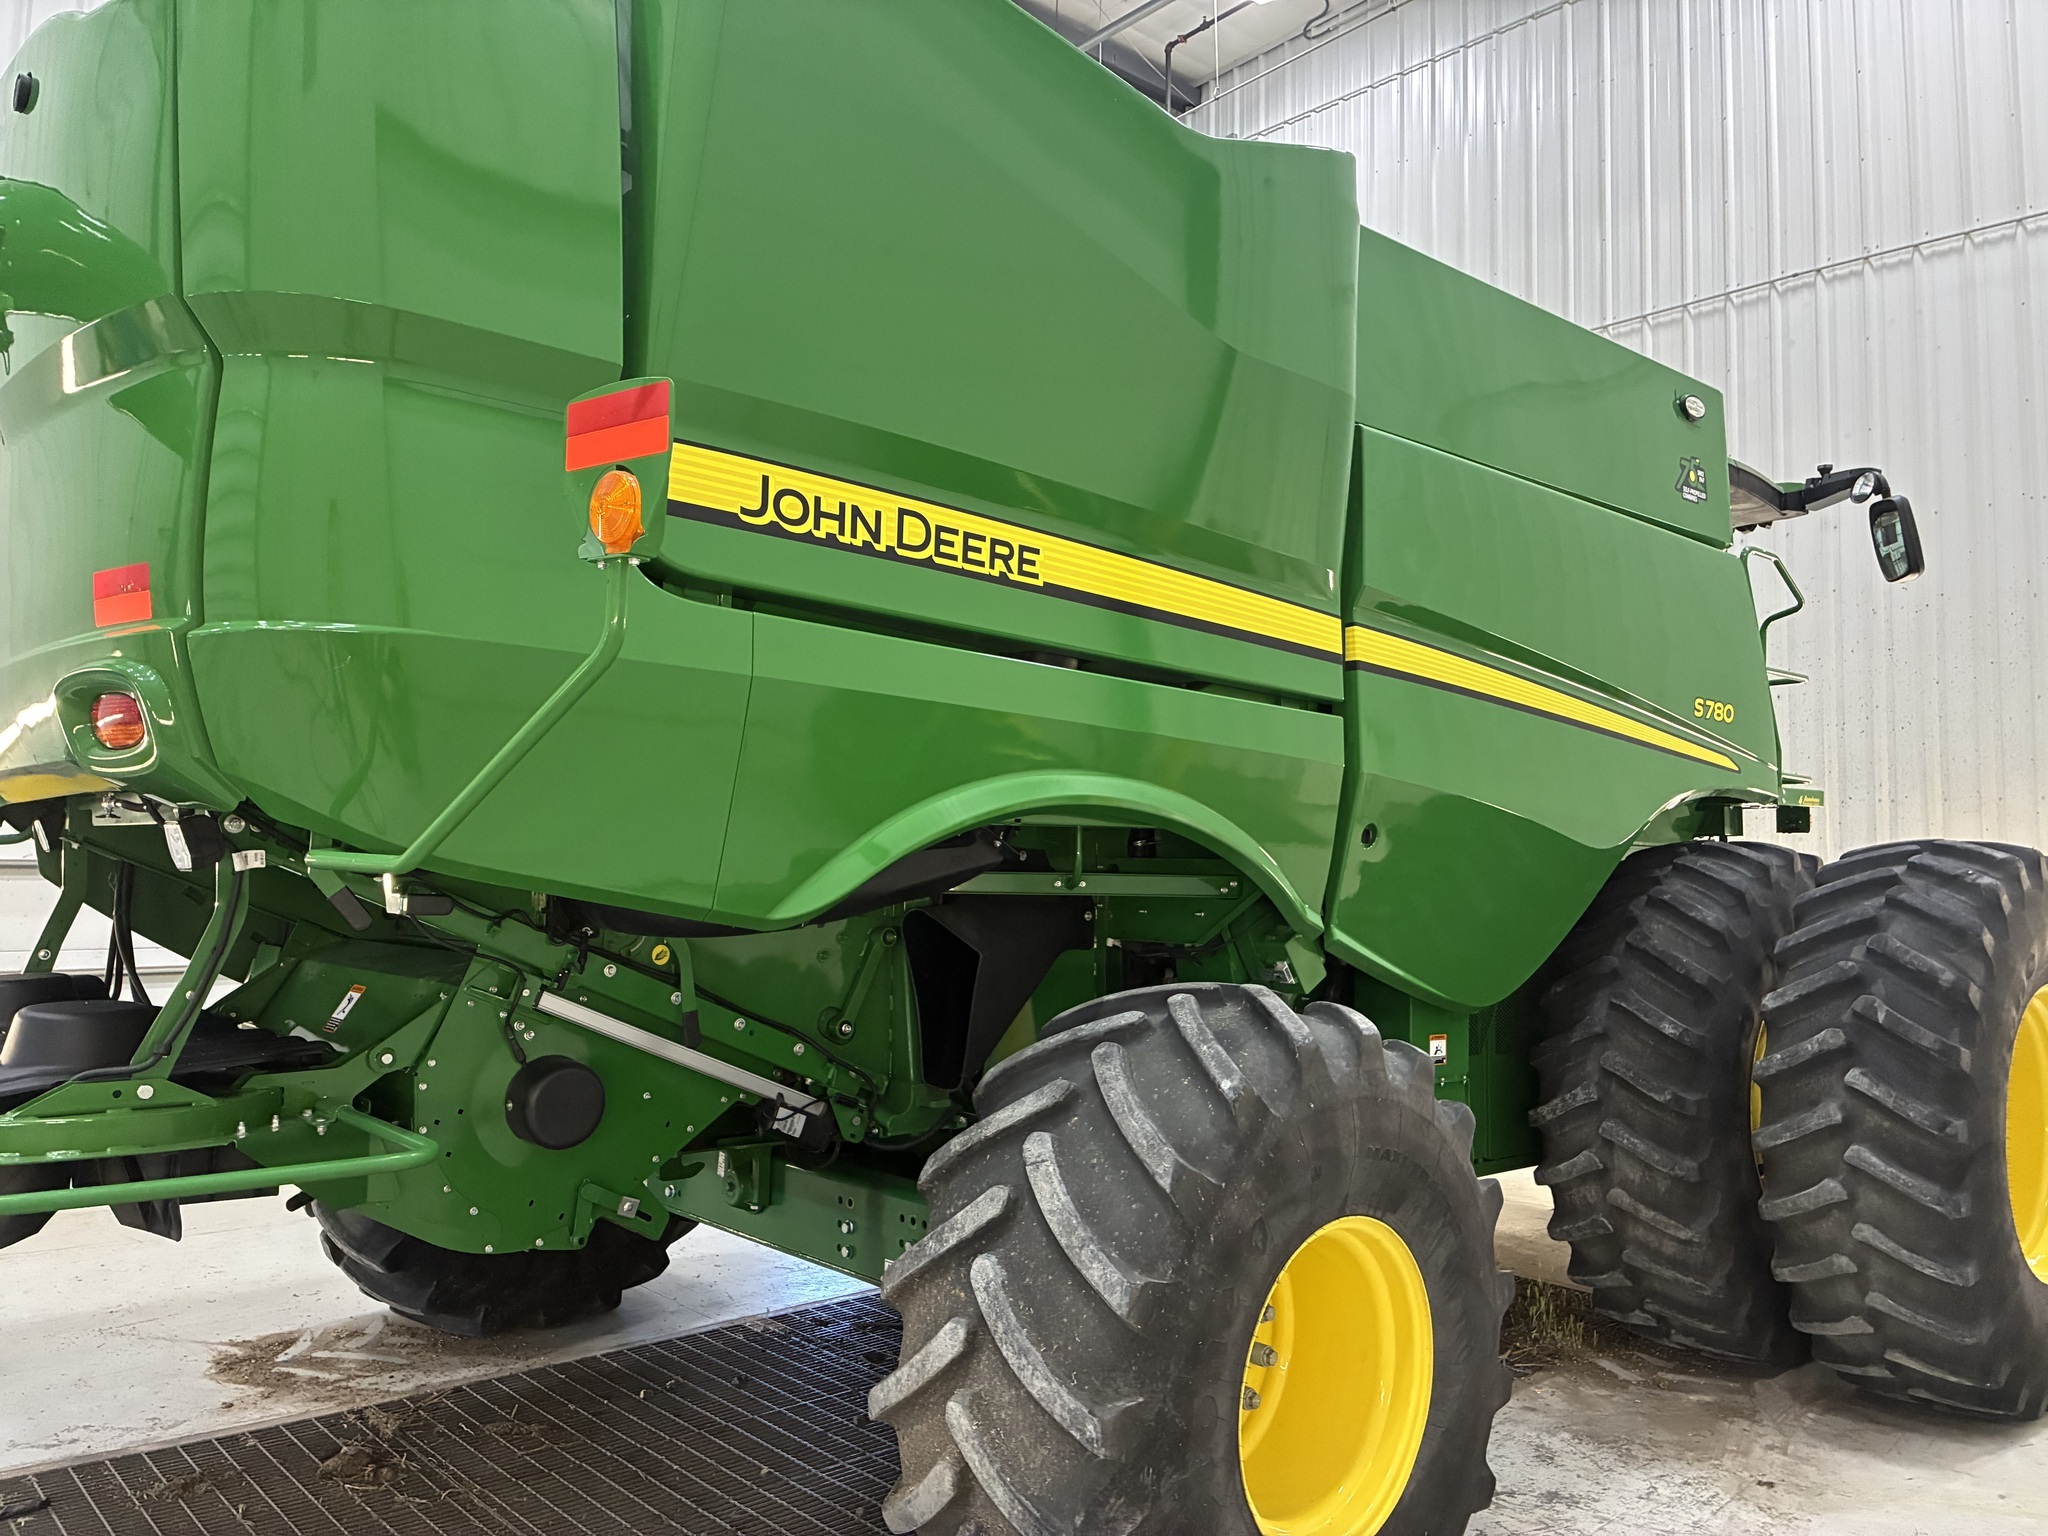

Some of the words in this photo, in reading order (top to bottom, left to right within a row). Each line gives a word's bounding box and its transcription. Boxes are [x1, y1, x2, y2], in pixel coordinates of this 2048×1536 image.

[739, 473, 883, 546] JOHN
[896, 506, 1042, 582] DEERE
[1693, 697, 1735, 724] S780
